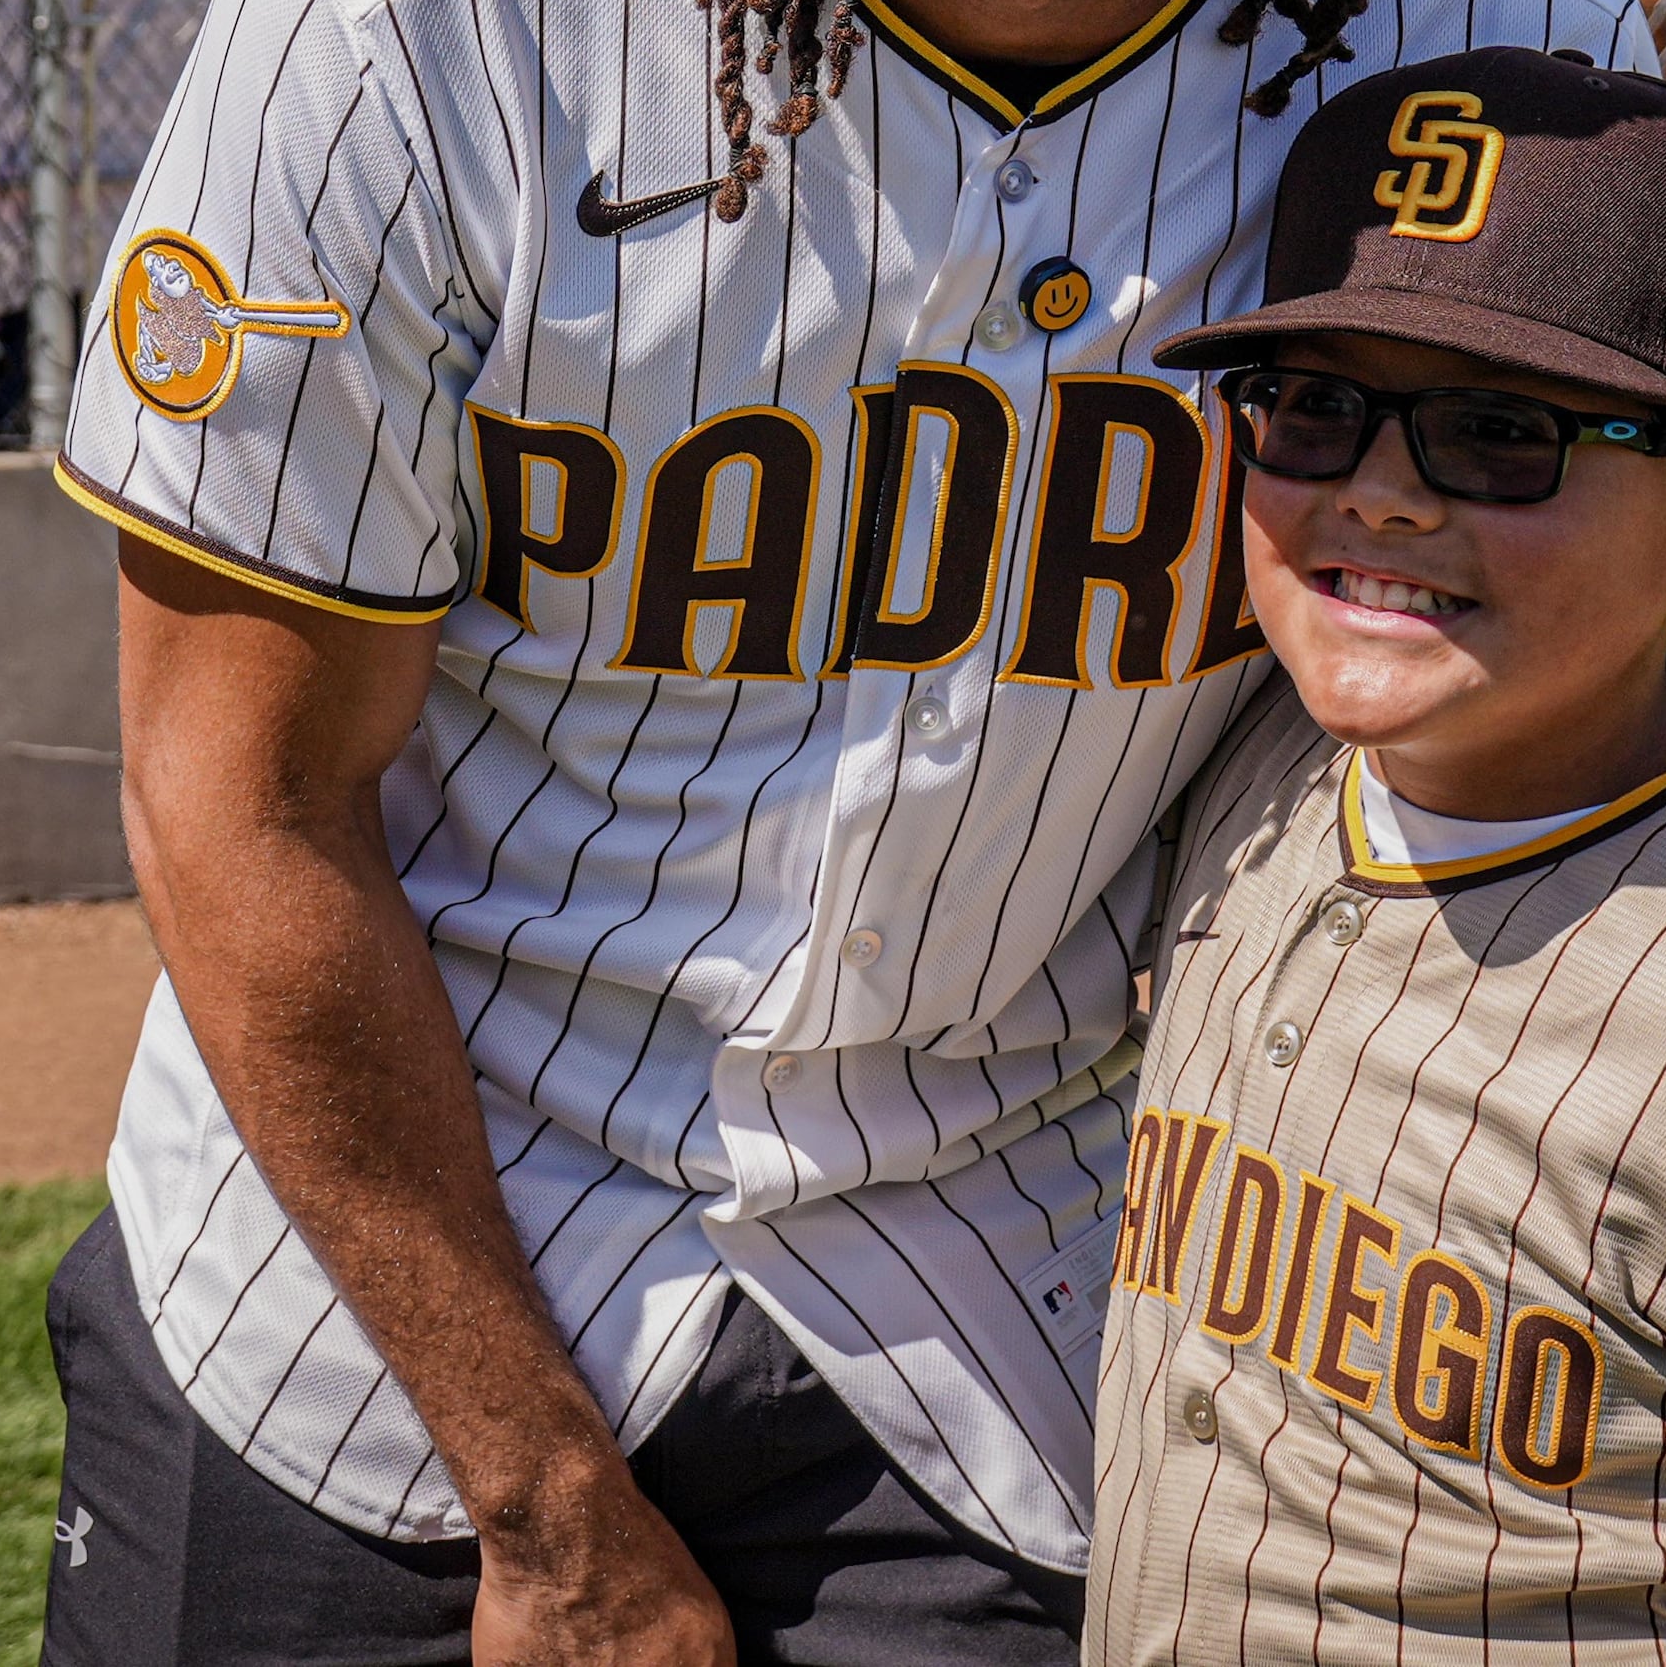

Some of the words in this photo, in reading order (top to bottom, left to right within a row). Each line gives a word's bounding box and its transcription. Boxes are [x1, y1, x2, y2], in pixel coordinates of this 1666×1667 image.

[1373, 90, 1505, 243] SD
[1110, 1105, 1230, 1307] AN
[1198, 1142, 1605, 1491] DIEGO
